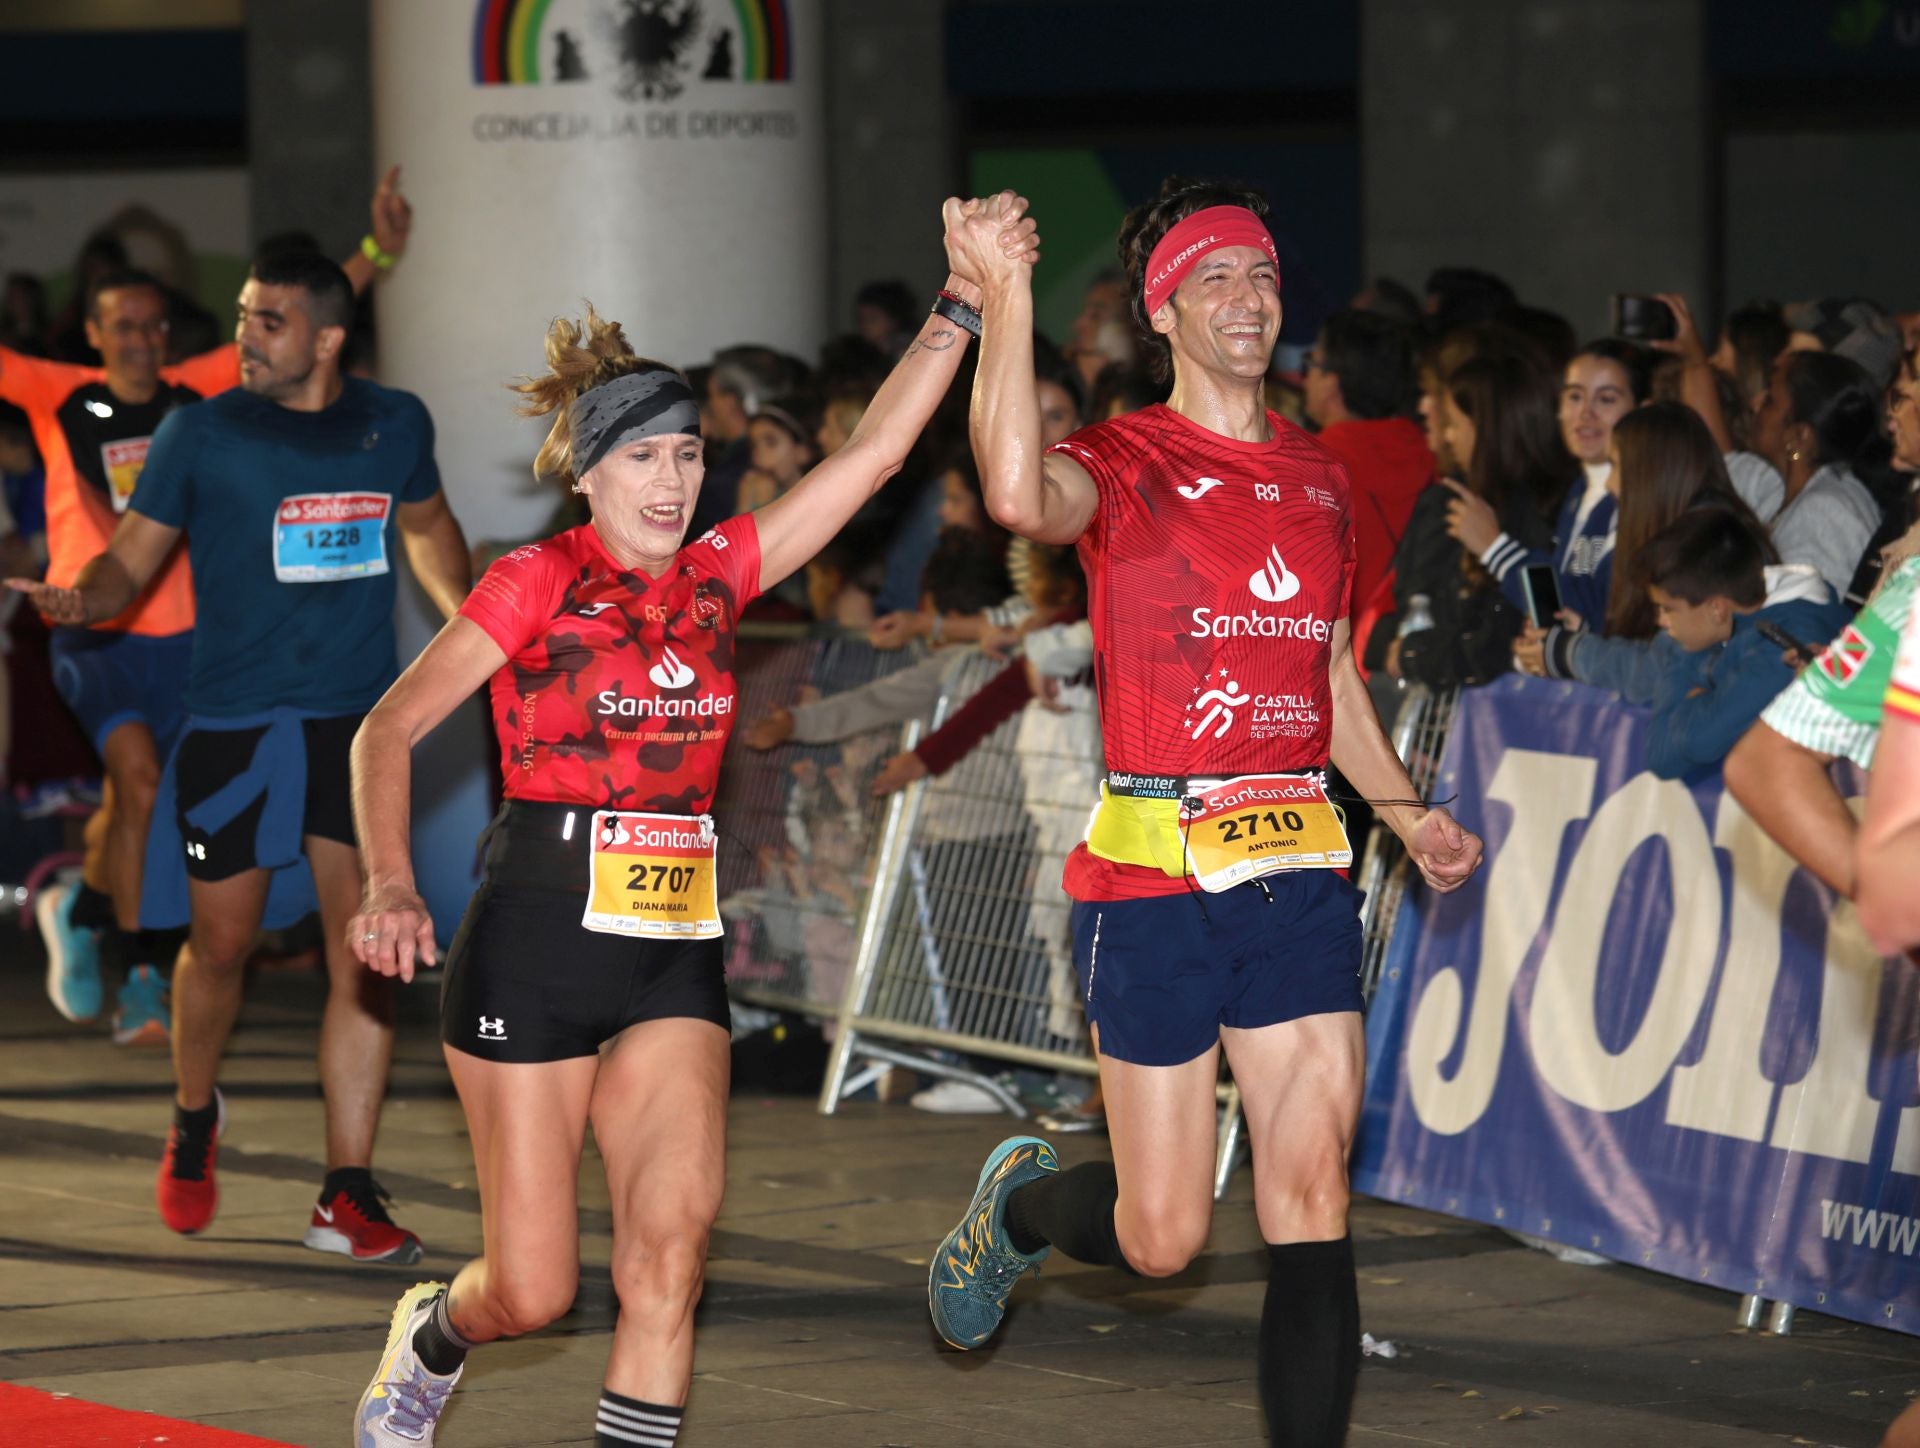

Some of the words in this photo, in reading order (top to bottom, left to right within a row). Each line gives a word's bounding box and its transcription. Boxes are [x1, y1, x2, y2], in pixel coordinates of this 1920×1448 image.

[645, 111, 679, 140] DE
[302, 500, 384, 520] Santander
[304, 527, 361, 549] 1228
[1190, 607, 1332, 643] Santander
[597, 690, 734, 717] Santander
[1252, 709, 1270, 722] LA
[605, 729, 641, 740] Carrera
[644, 731, 685, 742] nocturna
[686, 731, 698, 741] de
[1133, 788, 1177, 798] GIMNASIO
[1208, 784, 1317, 812] Santander
[1218, 811, 1304, 844] 2710
[1247, 838, 1298, 853] ANTONIO
[626, 863, 695, 893] 2707
